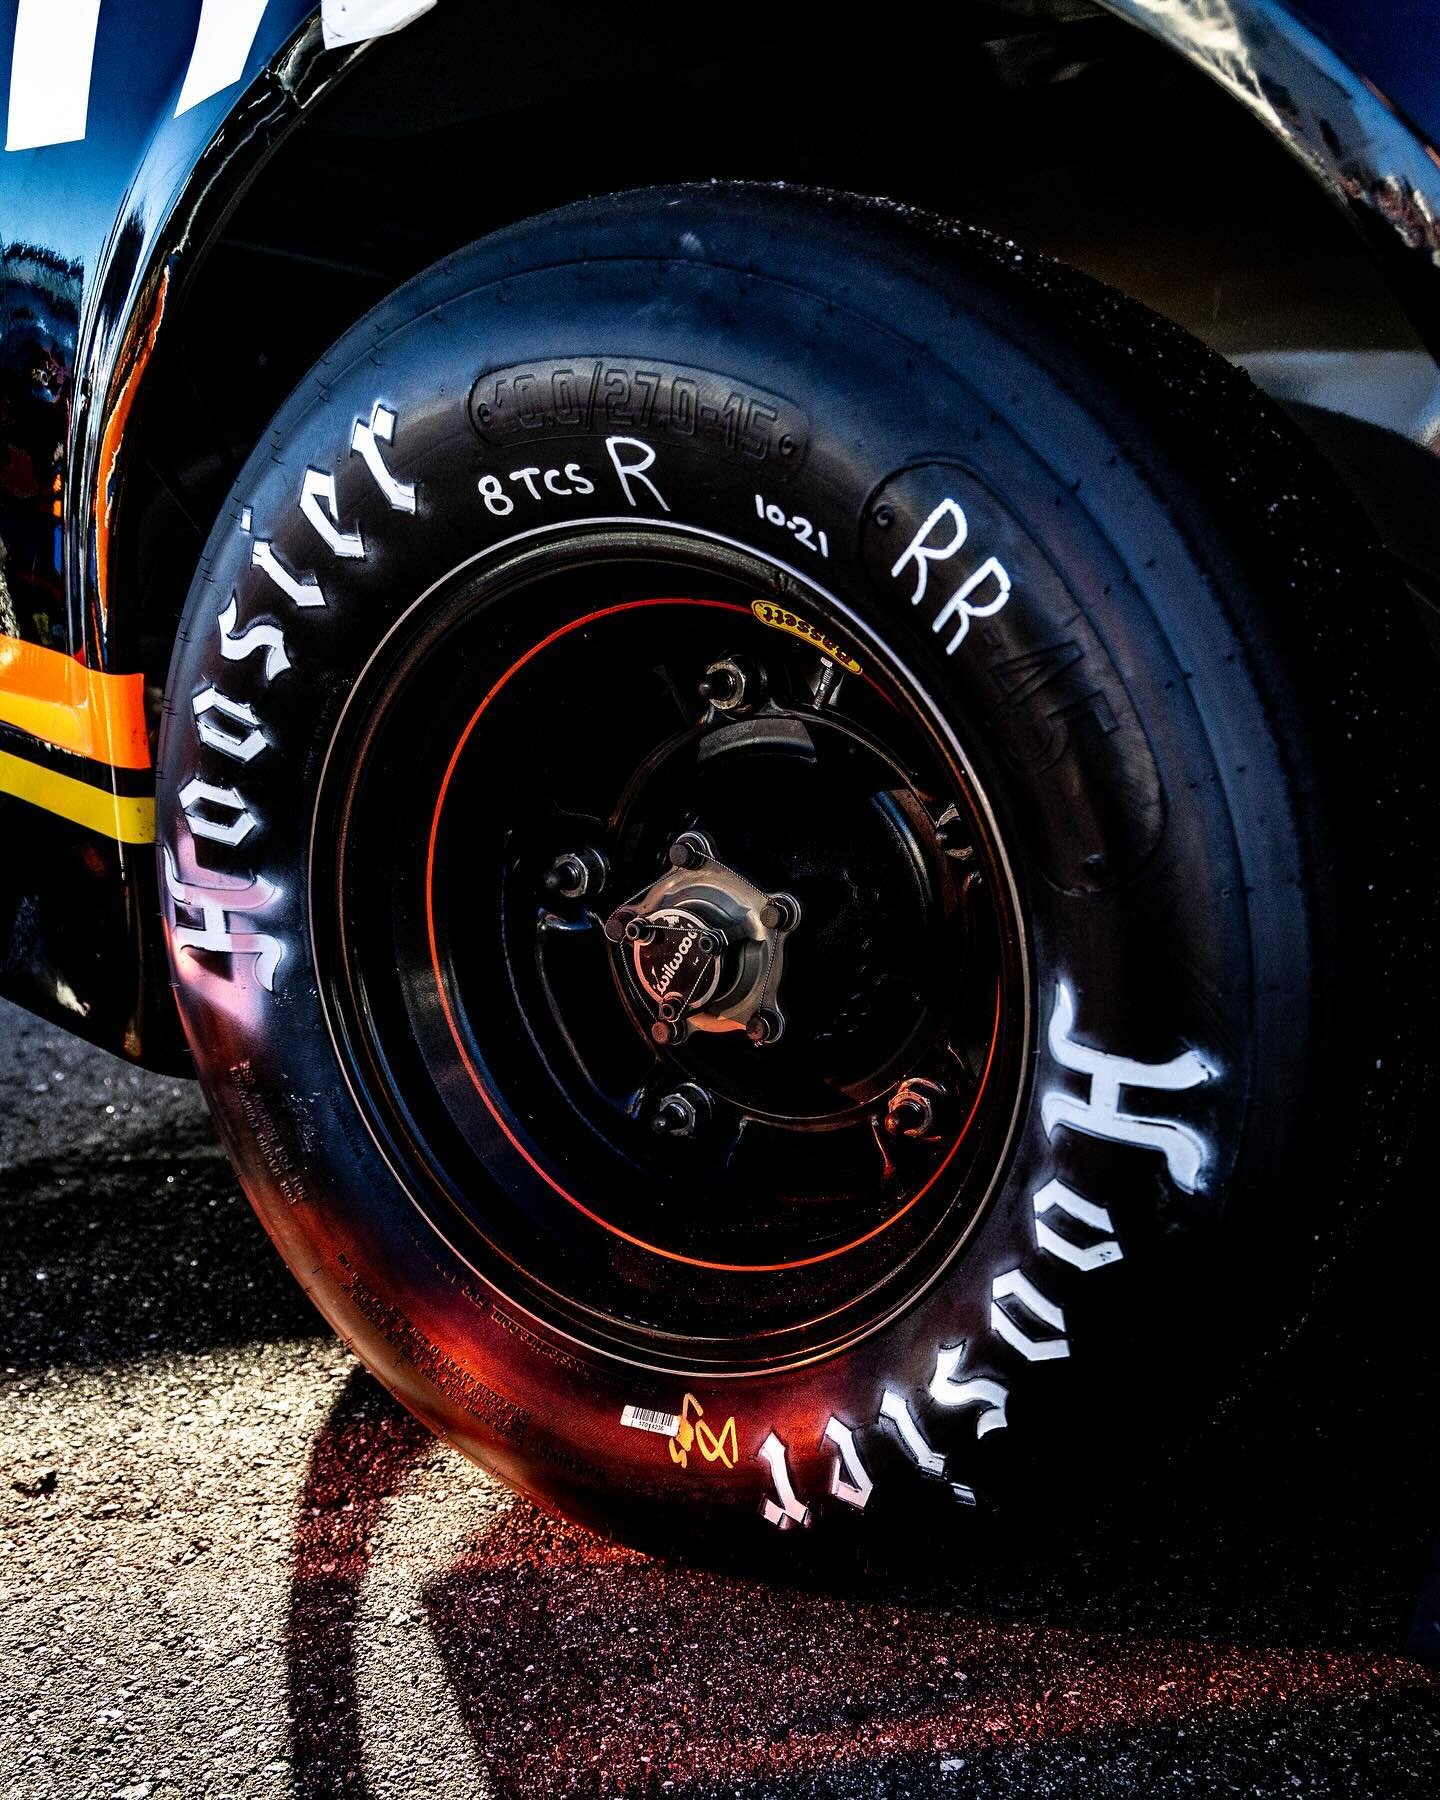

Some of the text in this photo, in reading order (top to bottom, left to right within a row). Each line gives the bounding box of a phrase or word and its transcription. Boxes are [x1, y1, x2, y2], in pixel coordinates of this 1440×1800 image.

[605, 435, 672, 512] R
[762, 606, 853, 665] Bassett
[163, 399, 418, 993] Hoosier
[655, 922, 699, 994] wilwood
[758, 982, 1218, 1528] Hoosier
